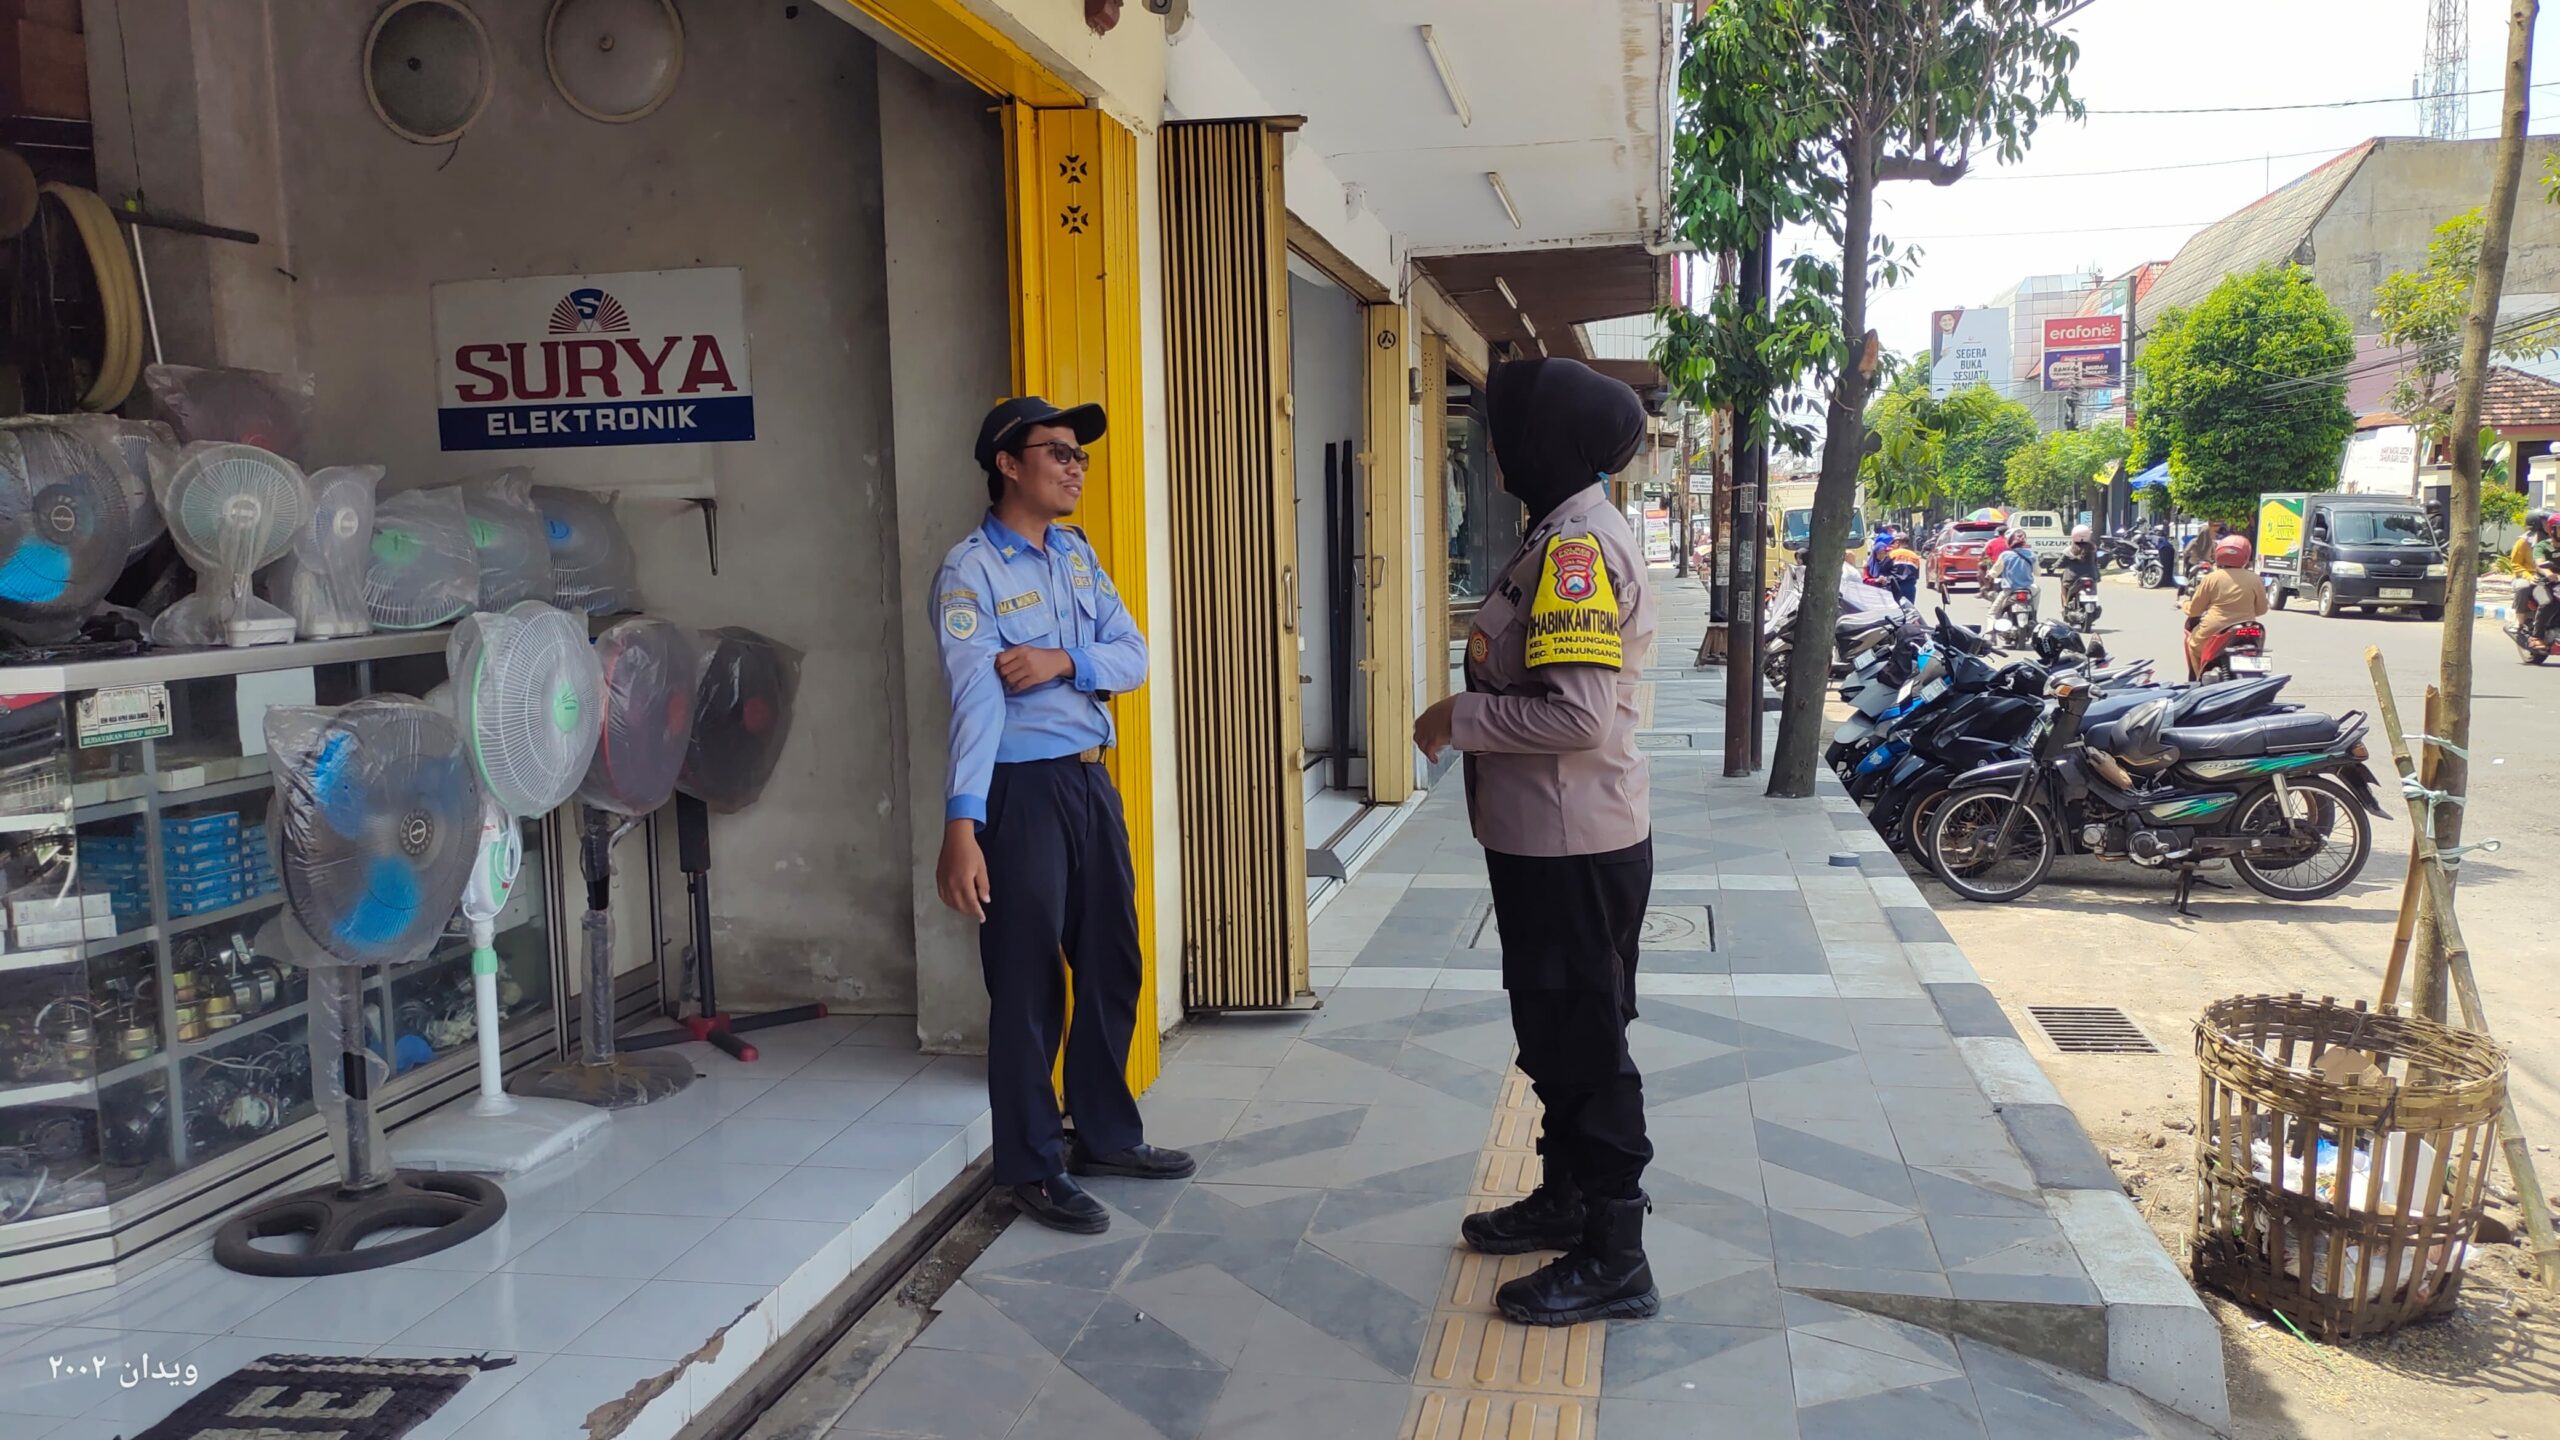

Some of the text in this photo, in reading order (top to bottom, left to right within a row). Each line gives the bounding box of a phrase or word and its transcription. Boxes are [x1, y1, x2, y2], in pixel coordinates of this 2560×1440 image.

[2050, 324, 2113, 341] erafone
[1956, 348, 1987, 359] SEGERA
[455, 334, 738, 403] SURYA
[1960, 359, 1982, 370] BUKA
[1953, 370, 1989, 381] SESUATU
[487, 404, 698, 436] ELEKTRONIK
[1529, 650, 1548, 660] KEC.
